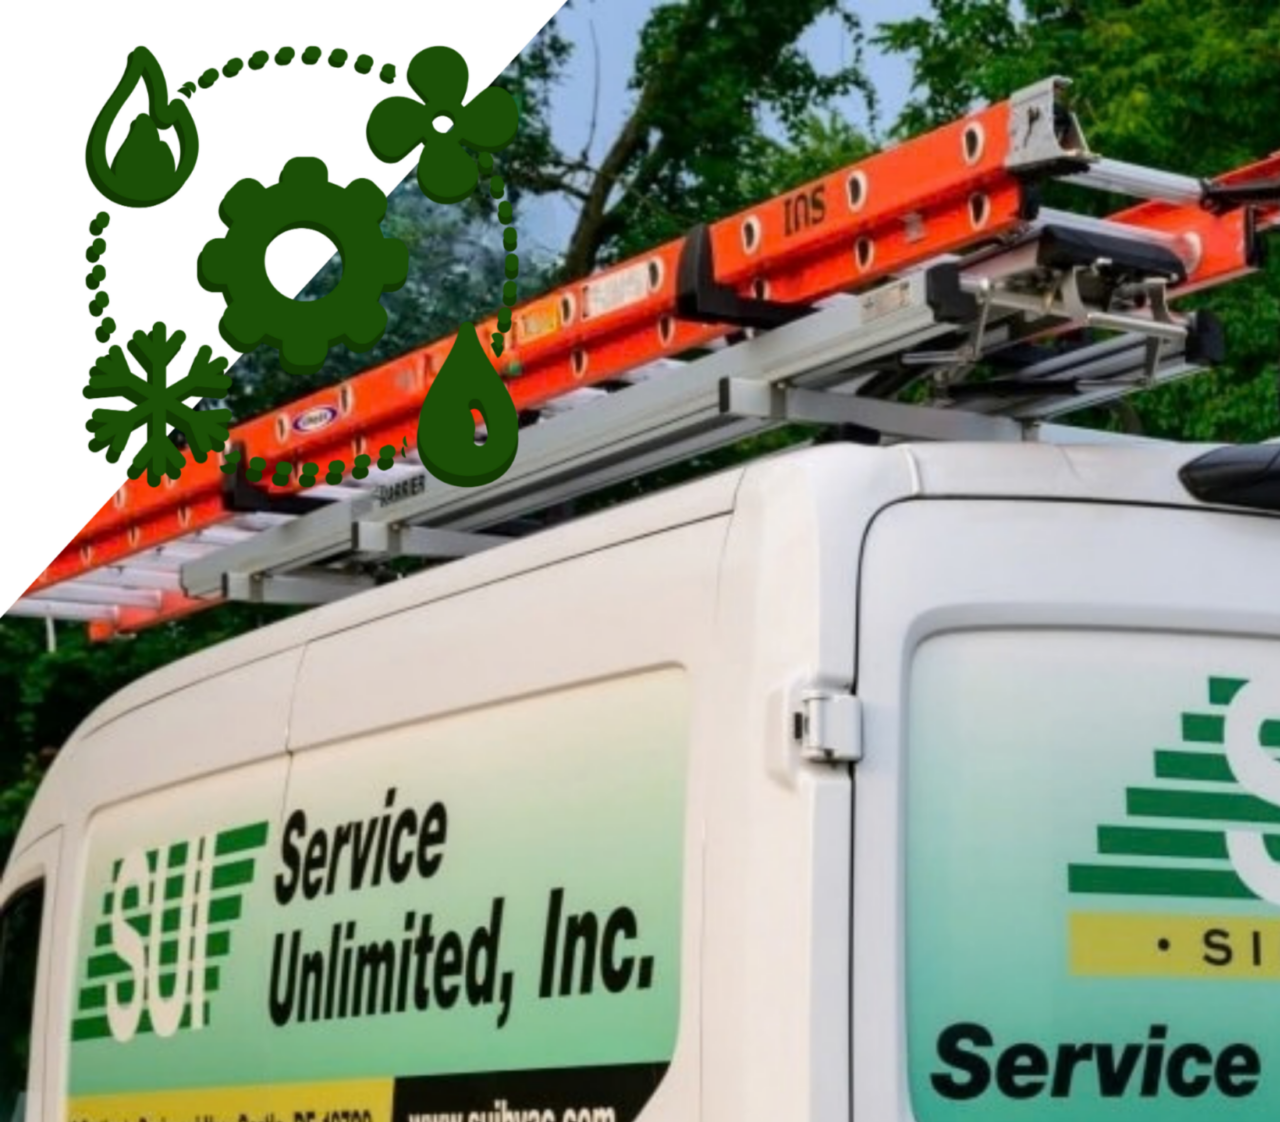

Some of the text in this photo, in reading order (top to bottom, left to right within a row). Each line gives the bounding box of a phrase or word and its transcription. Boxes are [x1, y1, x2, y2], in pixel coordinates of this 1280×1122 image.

[275, 787, 448, 906] Service
[106, 836, 216, 1043] SUI
[268, 886, 655, 1030] Unlimited, Inc.
[930, 1022, 1261, 1101] Service
